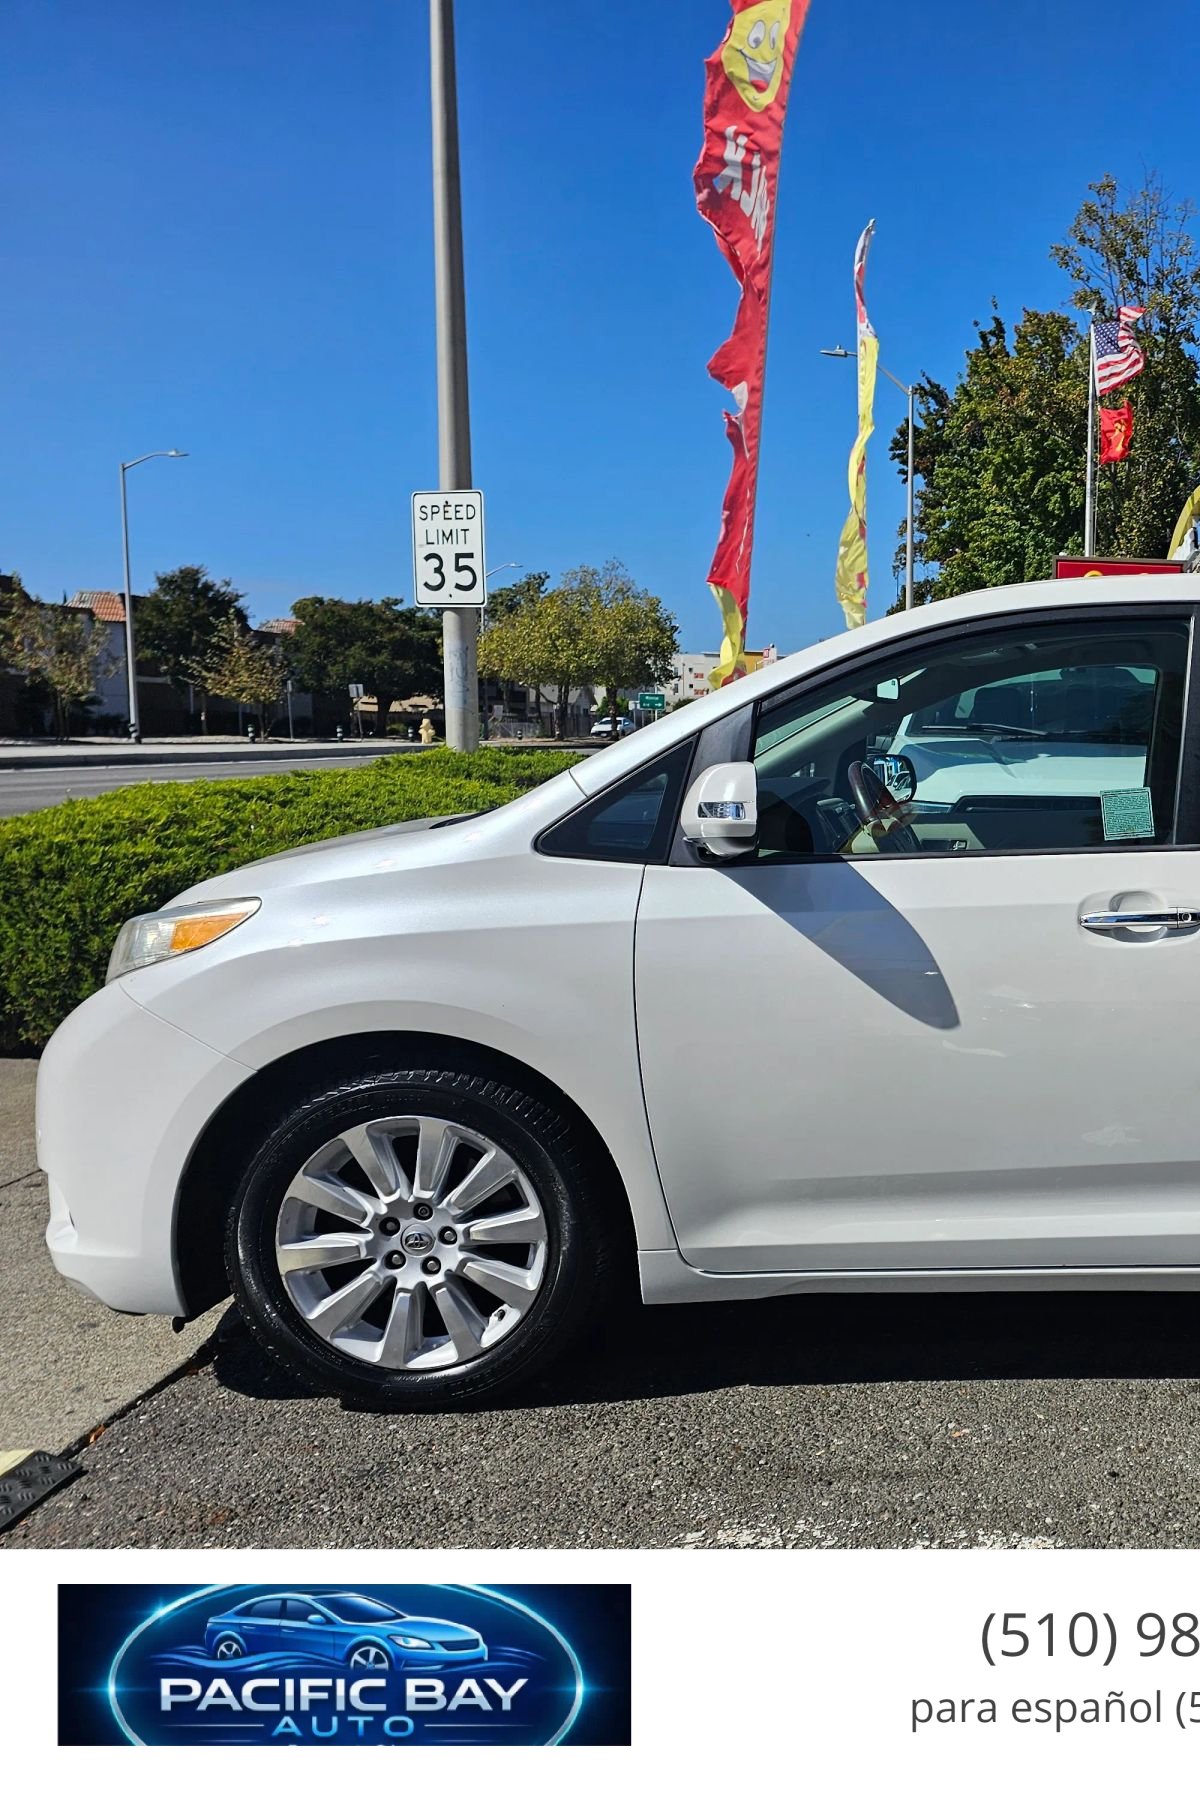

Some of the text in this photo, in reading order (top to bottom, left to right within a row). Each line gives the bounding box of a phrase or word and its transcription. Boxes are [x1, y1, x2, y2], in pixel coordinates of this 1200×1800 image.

[418, 503, 477, 522] SPEED
[425, 528, 471, 546] LIMIT
[422, 552, 478, 592] 35
